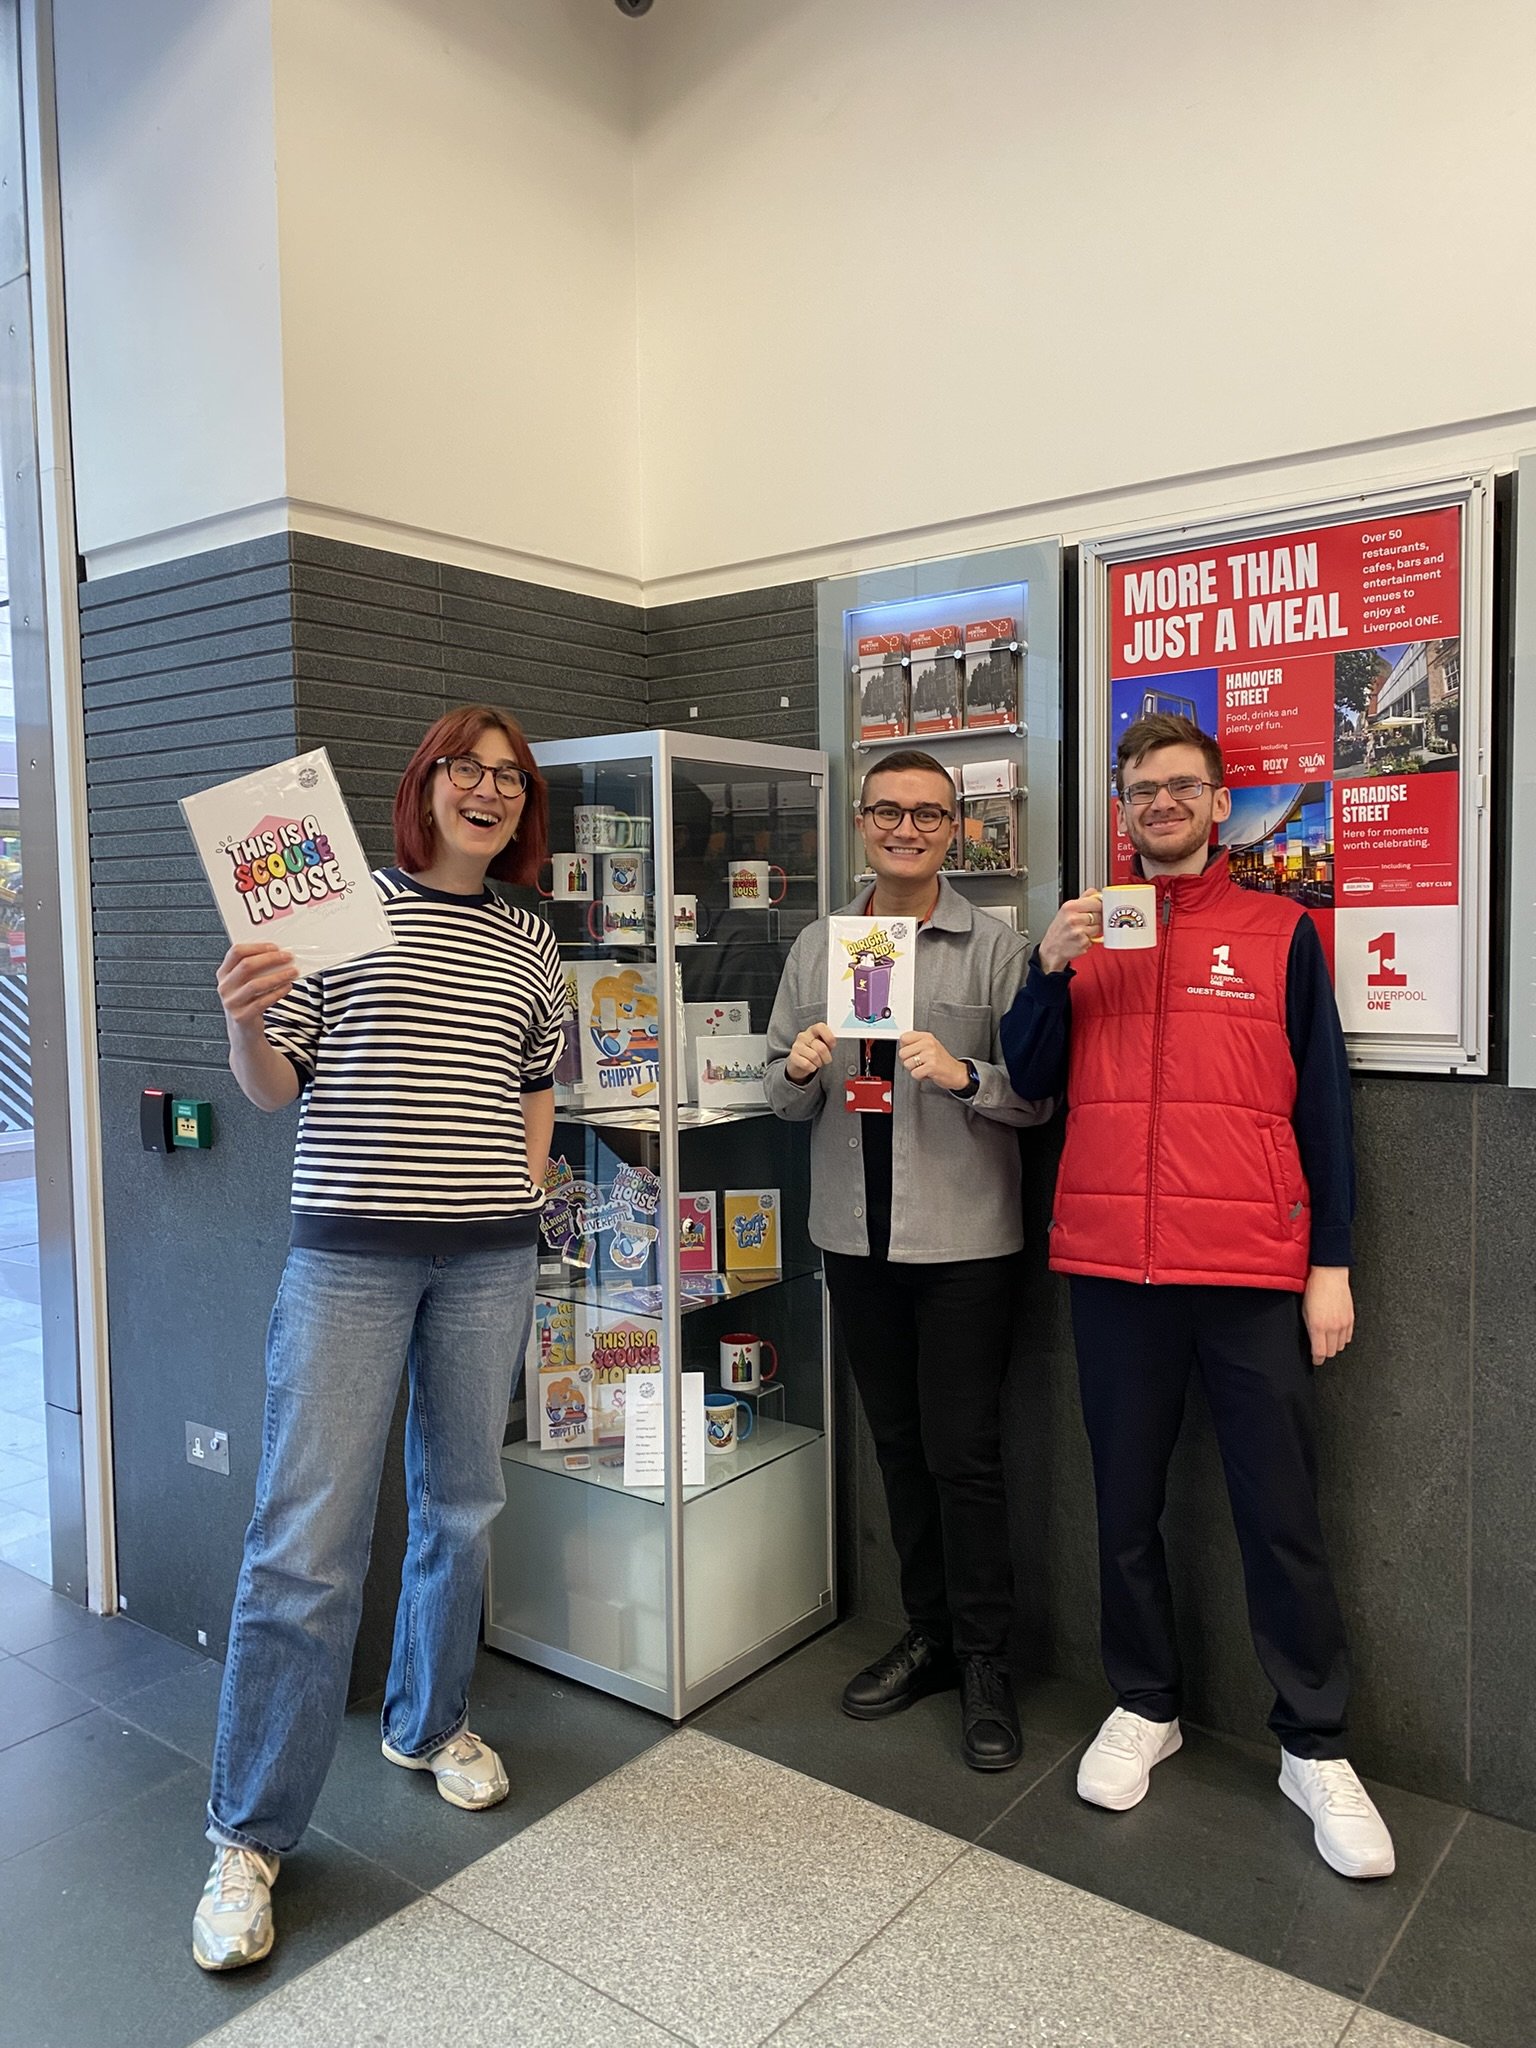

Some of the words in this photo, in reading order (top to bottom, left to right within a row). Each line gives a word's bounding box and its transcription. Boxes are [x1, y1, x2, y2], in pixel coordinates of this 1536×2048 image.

[1361, 533, 1387, 544] Over
[1389, 529, 1402, 539] 50
[1362, 542, 1429, 559] restaurants,
[1362, 562, 1395, 574] cafes,
[1397, 558, 1421, 569] bars
[1423, 553, 1444, 565] and
[1124, 559, 1218, 616] MORE
[1227, 542, 1318, 600] THAN
[1363, 569, 1441, 589] entertainment
[1363, 591, 1401, 604] venues
[1403, 589, 1415, 598] to
[1363, 607, 1392, 619] enjoy
[1394, 604, 1405, 614] at
[1123, 612, 1204, 664] JUST
[1214, 607, 1237, 653] A
[1249, 592, 1349, 648] MEAL
[1363, 618, 1412, 633] Liverpool
[1415, 614, 1442, 626] ONE.
[1226, 668, 1283, 690] HANOVER
[1226, 687, 1269, 708] STREET
[1226, 712, 1250, 722] Food,
[1251, 710, 1279, 719] drinks
[1281, 707, 1298, 716] and
[1226, 724, 1253, 735] plenty
[1255, 721, 1264, 731] of
[1266, 721, 1283, 730] fun.
[1263, 758, 1288, 771] ROXY
[1342, 784, 1407, 805] PARADISE
[1342, 804, 1390, 823] STREET
[225, 830, 277, 866] THIS
[277, 823, 302, 849] IS
[301, 815, 322, 841] A
[1343, 829, 1366, 838] Here
[1367, 827, 1381, 837] for
[1383, 826, 1429, 836] moments
[1343, 840, 1371, 850] worth
[1372, 838, 1431, 849] celebrating.
[234, 835, 335, 893] SCOUSE
[243, 859, 347, 925] HOUSE
[733, 886, 758, 898] HOUSE
[1109, 909, 1144, 928] LIVERPOOL
[847, 930, 889, 956] ALRIGHT
[873, 942, 896, 959] LID?
[1210, 974, 1244, 984] LIVERPOOL
[1187, 986, 1215, 995] GUEST
[1215, 989, 1256, 1000] SERVICES
[1367, 991, 1427, 1001] LIVERPOOL
[1367, 1001, 1391, 1010] ONE
[600, 1066, 641, 1089] CHIPPY
[621, 1166, 641, 1179] THIS
[642, 1173, 654, 1183] IS
[612, 1184, 656, 1210] HOUSE
[541, 1210, 572, 1233] ALRIGHT
[551, 1223, 568, 1238] LID?
[582, 1211, 633, 1232] LIVERPOOL
[592, 1331, 626, 1349] THIS
[629, 1330, 643, 1348] IS
[645, 1329, 657, 1347] A
[592, 1346, 660, 1369] SCOUSE
[549, 1427, 571, 1438] CHIPPY
[573, 1425, 585, 1436] TEA
